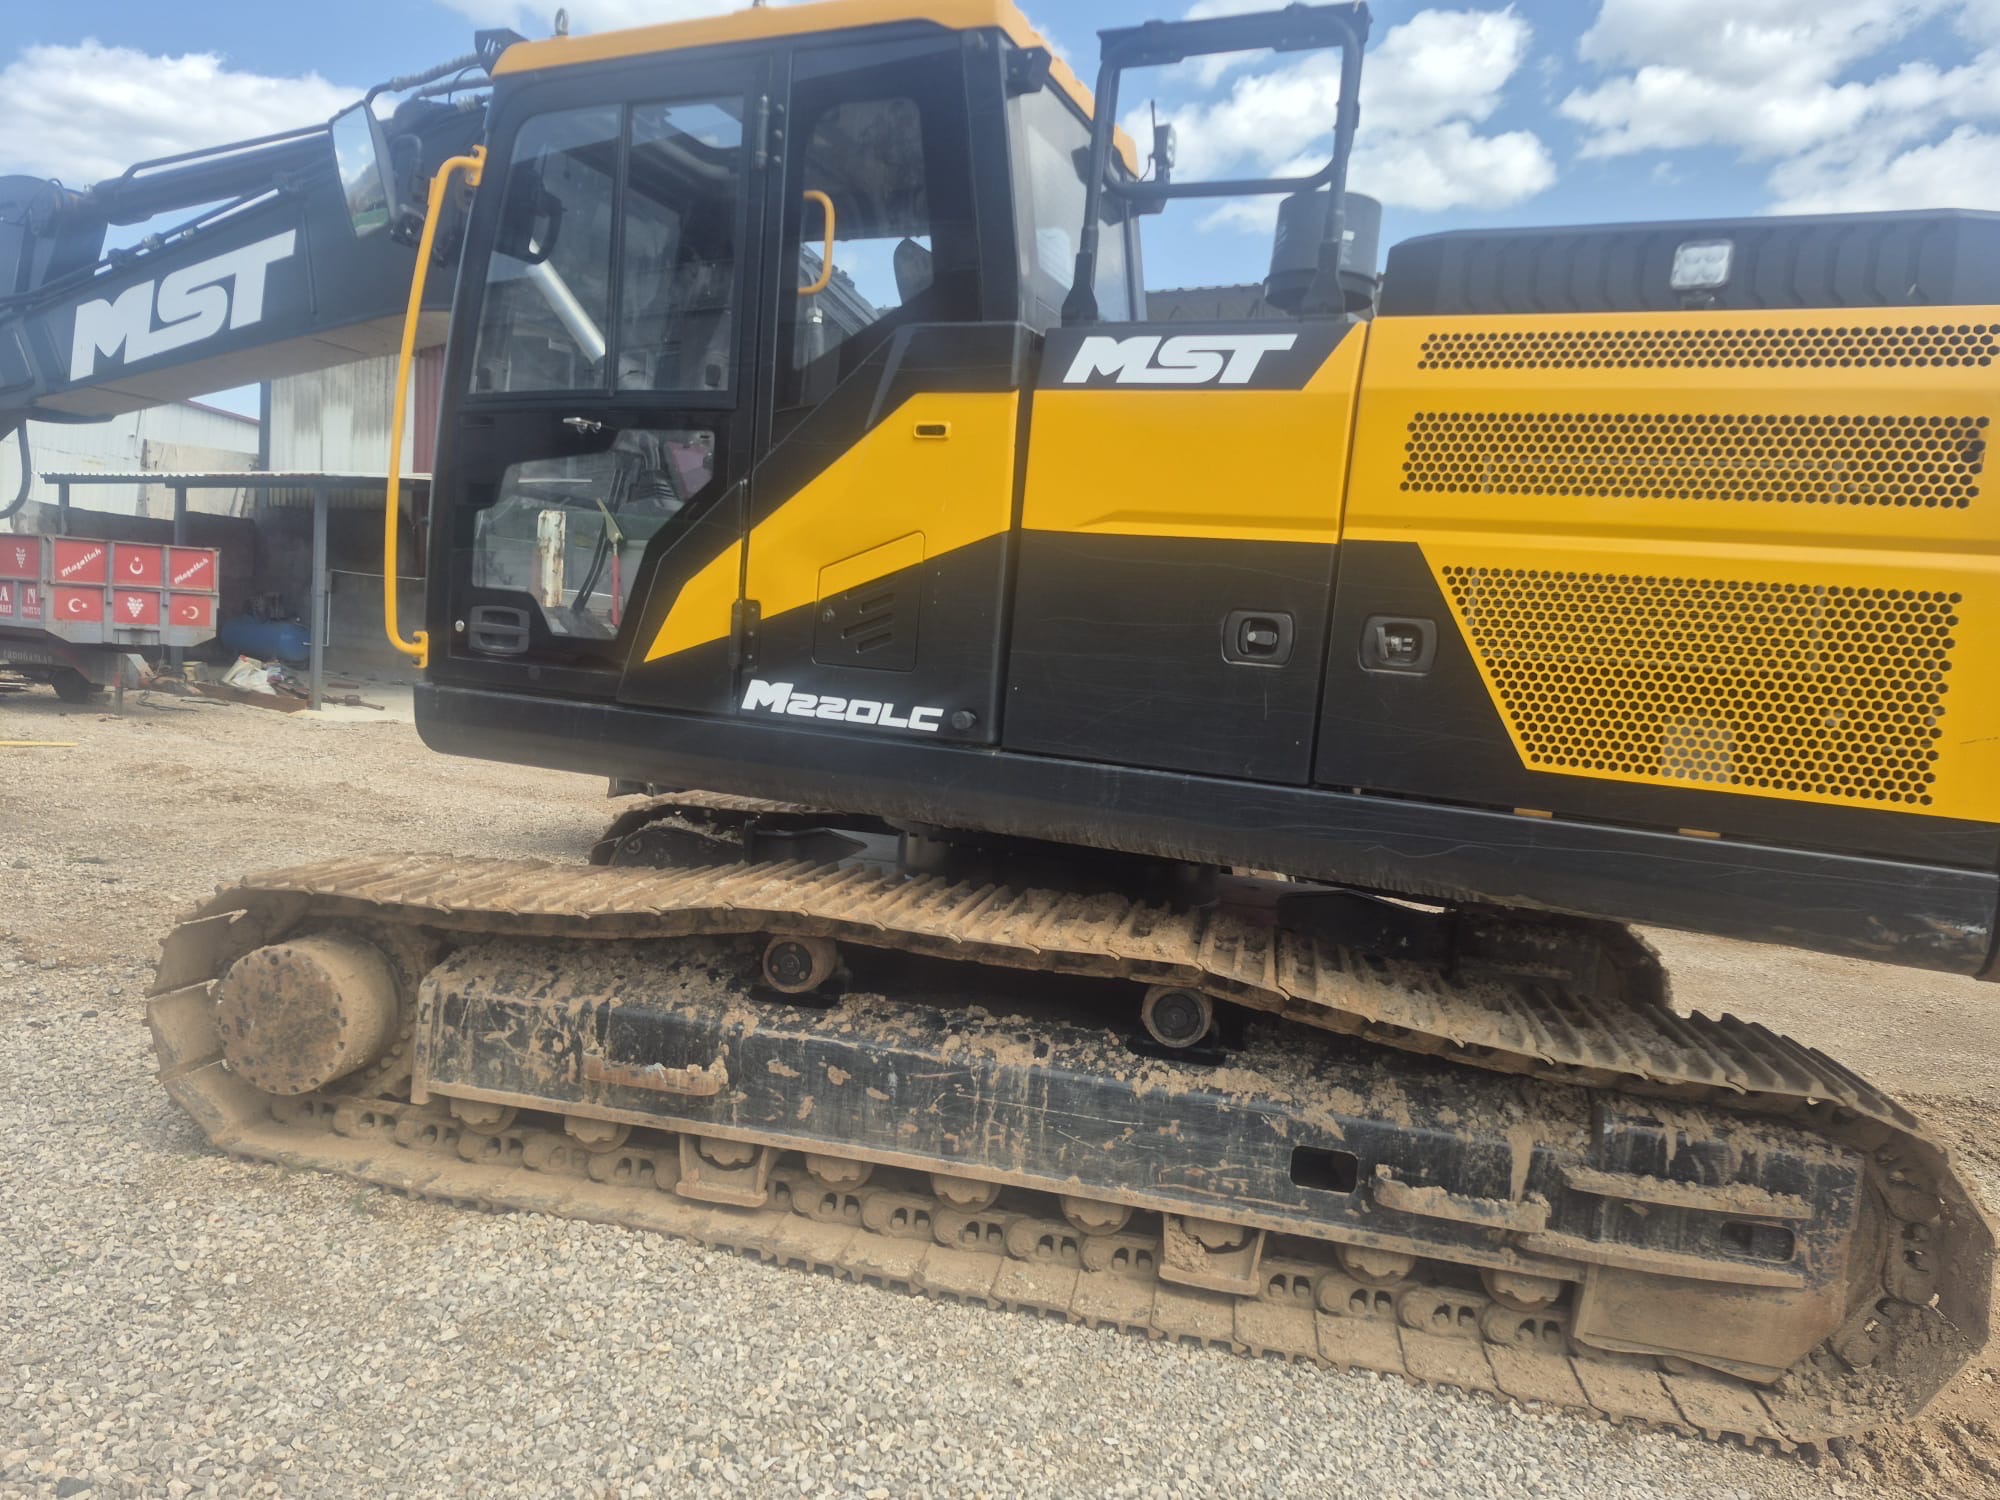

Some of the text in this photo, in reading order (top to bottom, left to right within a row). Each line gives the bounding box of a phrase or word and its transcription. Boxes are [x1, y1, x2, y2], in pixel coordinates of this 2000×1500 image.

[69, 228, 297, 382] MST
[1062, 333, 1298, 384] MST
[741, 679, 945, 732] M220LC
